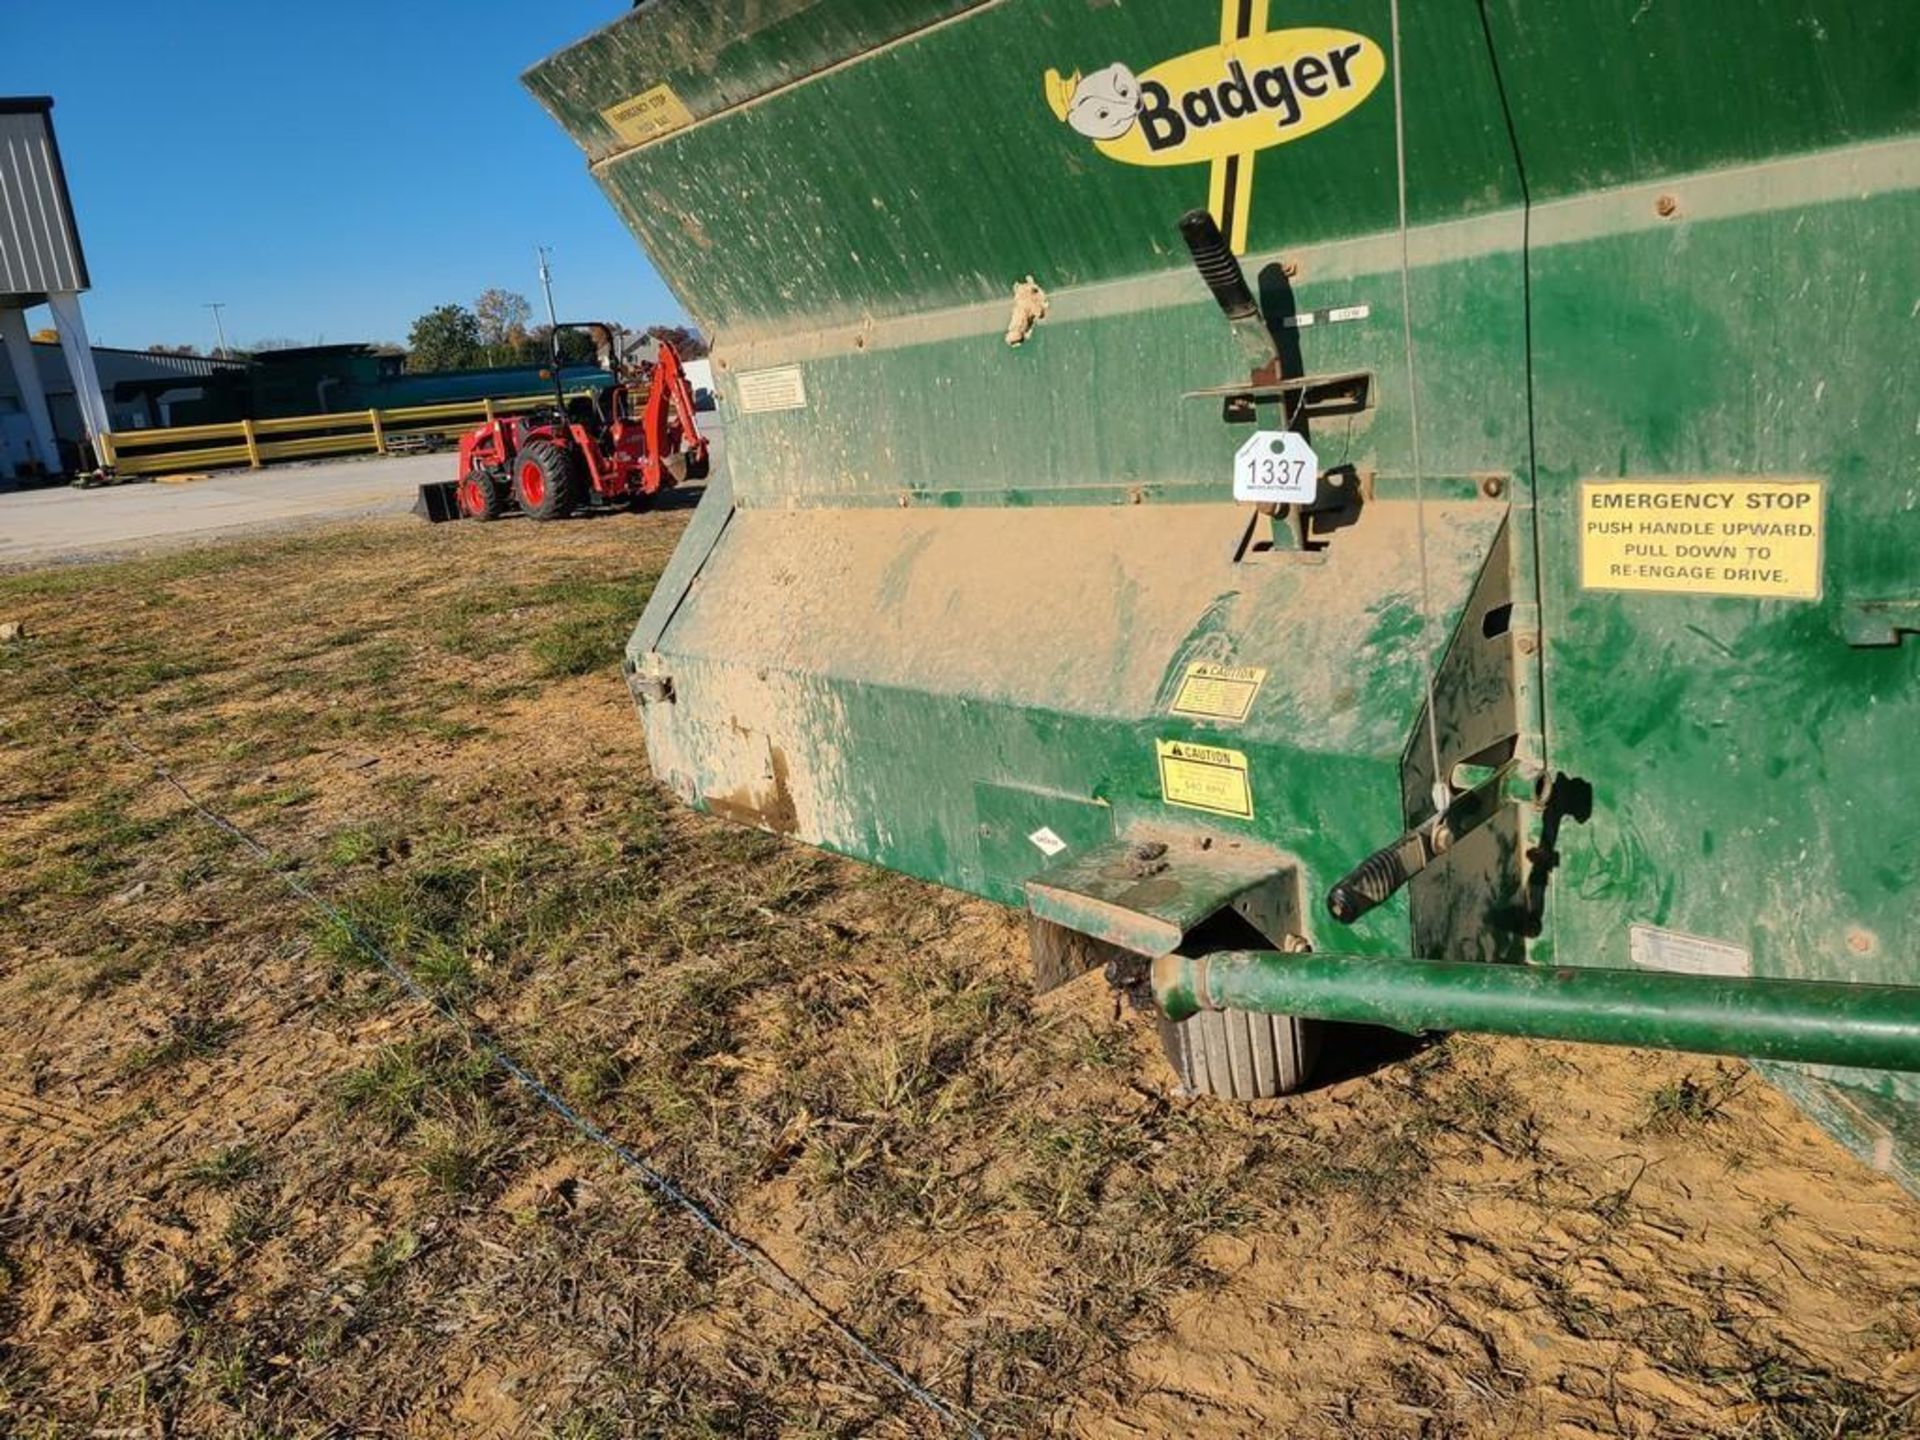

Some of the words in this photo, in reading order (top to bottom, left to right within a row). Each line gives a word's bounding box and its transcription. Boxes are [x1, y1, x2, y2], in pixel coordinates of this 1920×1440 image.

[1138, 43, 1361, 151] Badger
[1247, 459, 1306, 484] 1337
[1591, 493, 1734, 509] EMERGENCY
[1746, 493, 1811, 510] STOP
[1588, 522, 1633, 534] PUSH
[1639, 522, 1714, 535] HANDLE
[1722, 523, 1816, 537] UPWARD.
[1625, 544, 1667, 557] PULL
[1676, 545, 1736, 558] DOWN
[1746, 546, 1771, 560] TO
[1610, 564, 1715, 579] RE-ENGAGE
[1724, 567, 1788, 583] DRIVE.
[1210, 666, 1256, 679] CAUTION
[1184, 747, 1231, 764] CAUTION
